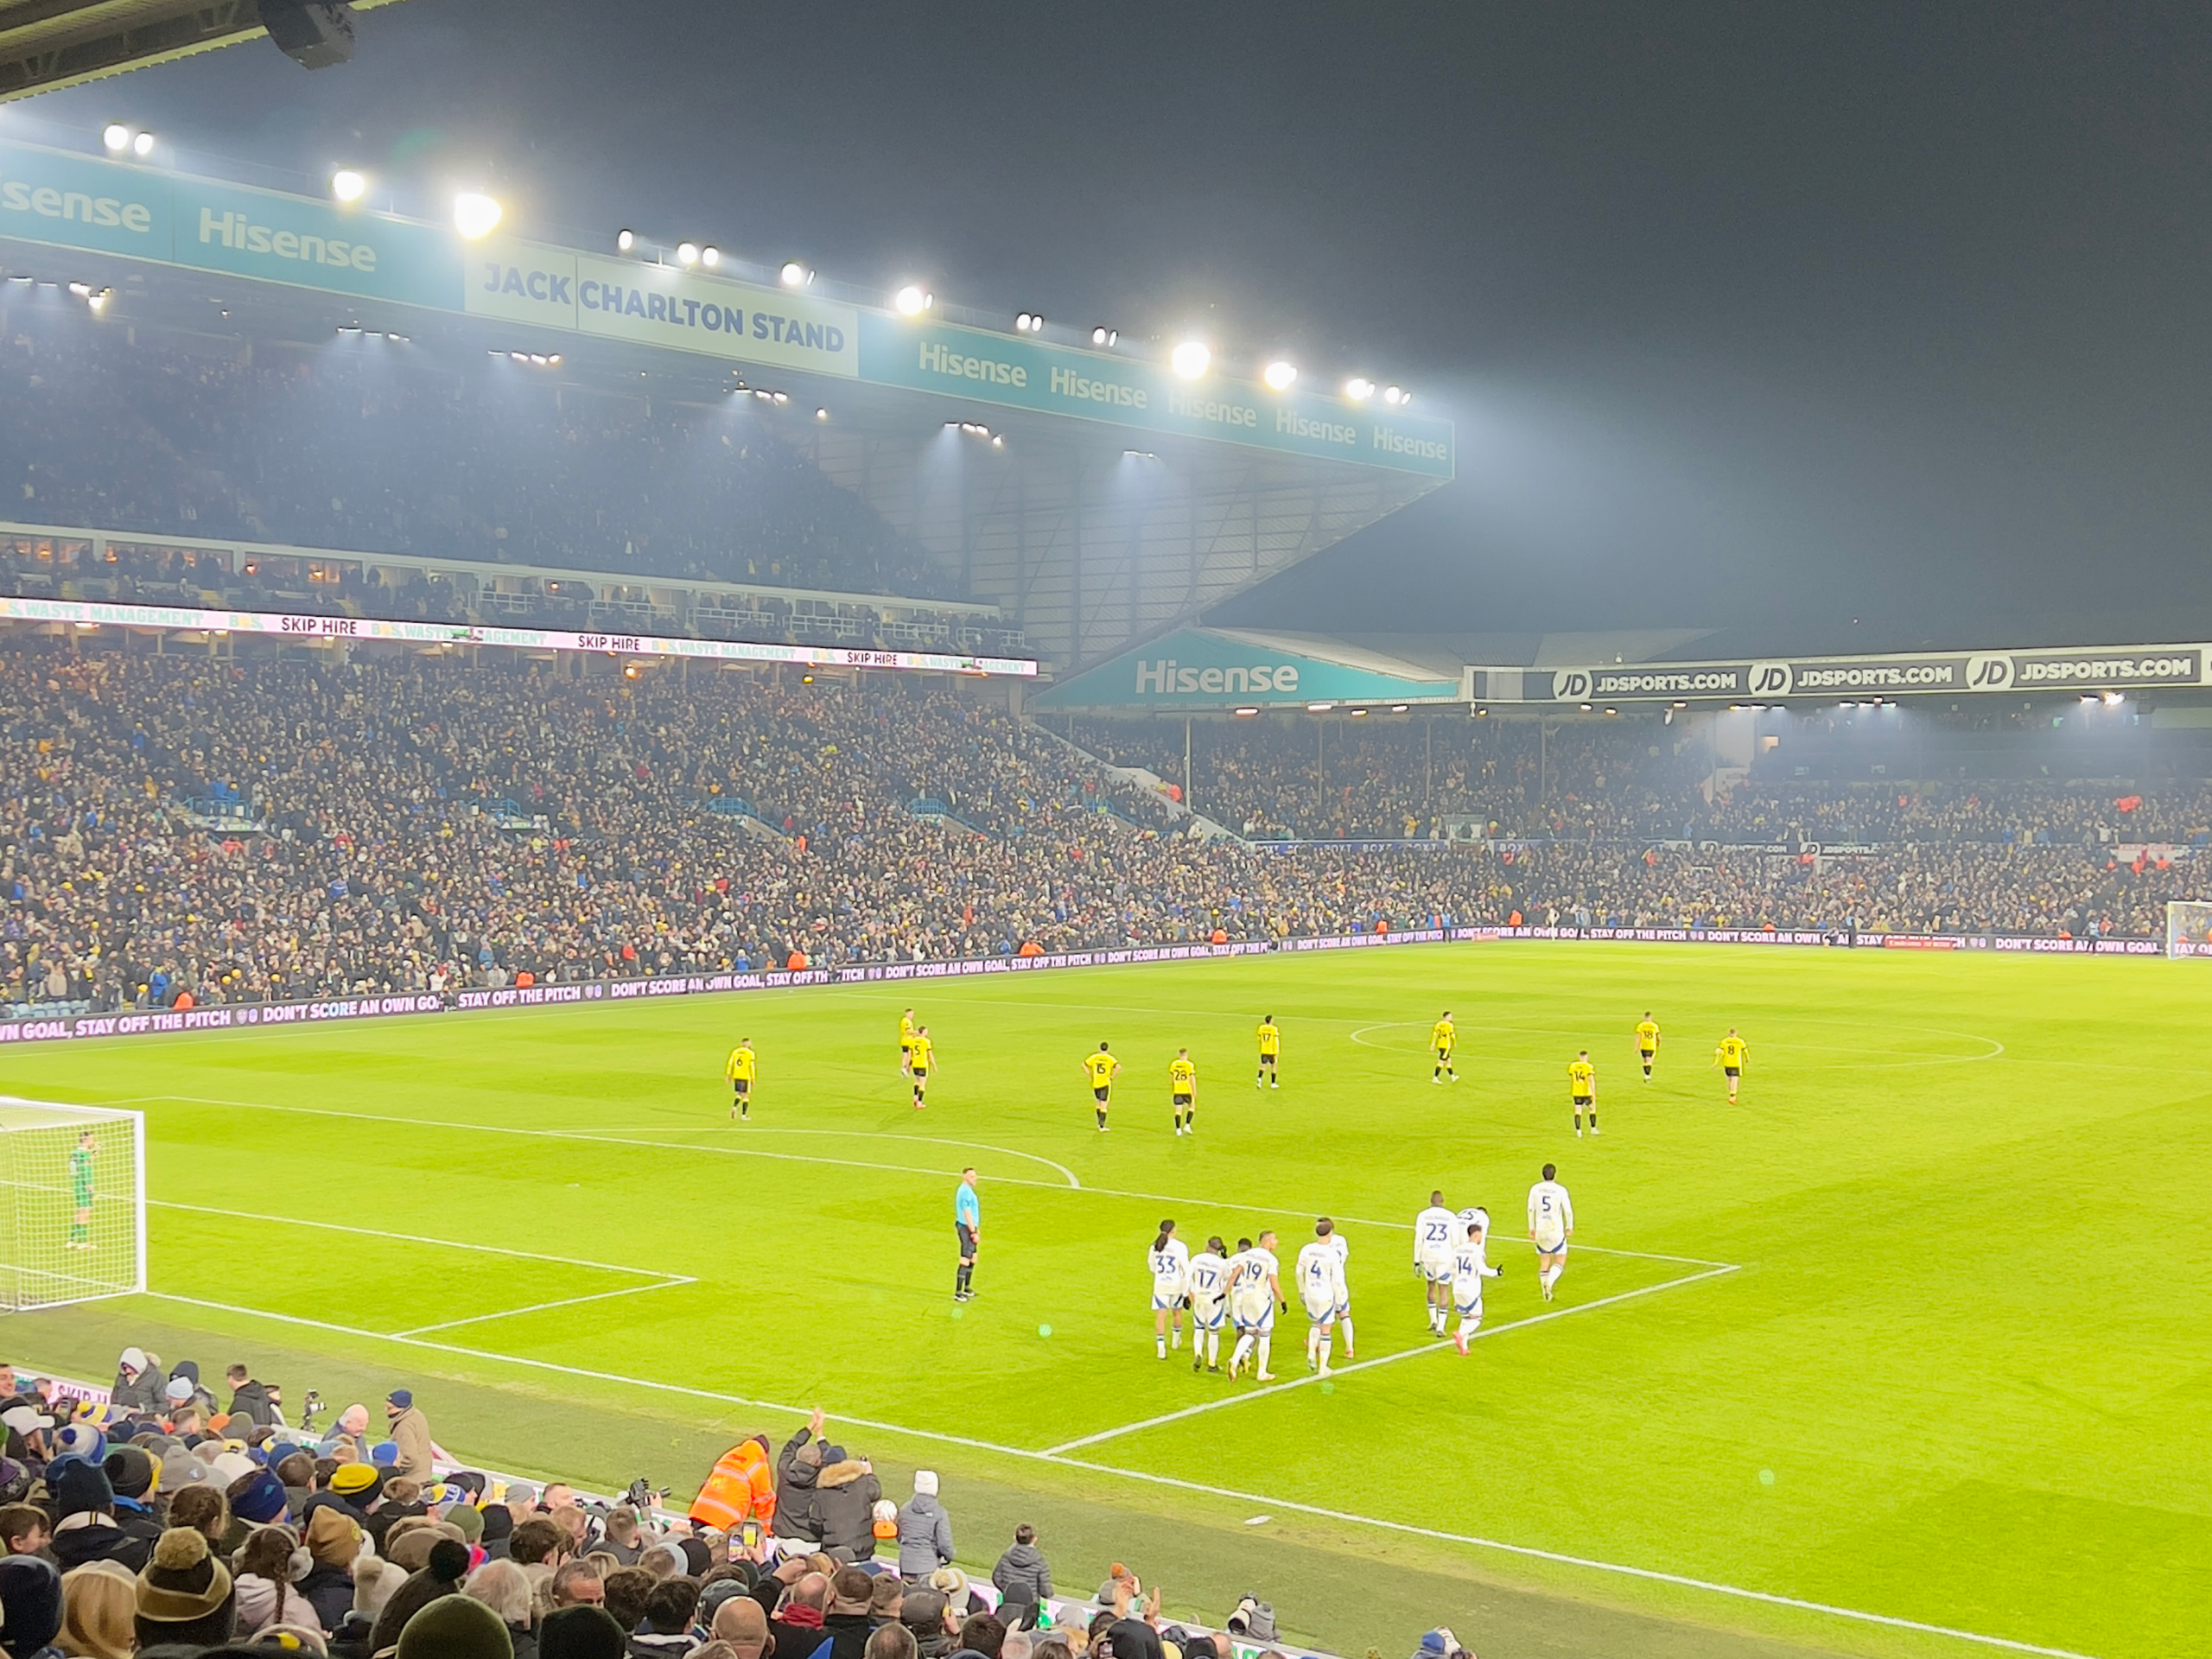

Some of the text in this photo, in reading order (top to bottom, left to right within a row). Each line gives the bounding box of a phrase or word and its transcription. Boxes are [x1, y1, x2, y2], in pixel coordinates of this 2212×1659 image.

[1, 180, 151, 233] sense
[200, 207, 377, 272] Hisense
[484, 262, 845, 353] JACK CHARLTON STAND
[918, 340, 1027, 388] Hisense
[1050, 366, 1148, 410] Hisense
[1168, 388, 1257, 428] Hisense
[1275, 407, 1357, 445] Hisense
[1373, 425, 1447, 461] Hisense
[26, 602, 83, 620] WASTE
[90, 605, 204, 626] MANAGEMENT
[282, 617, 358, 634] SKIP HIRE
[484, 630, 547, 645] AGEMENT
[578, 635, 641, 651] SKIP HIRE
[678, 642, 718, 655] WASTE
[721, 644, 797, 659] MANAGEMENT
[848, 652, 898, 665] SKIP HIRE
[982, 660, 1026, 672] AGEMENT
[1972, 658, 2192, 686] JD JDSPORTS.COM
[1135, 660, 1300, 694] Hisense
[1560, 672, 1737, 696] JD JDSPORTS.COM
[1754, 665, 1953, 691] JD JDSPORTS.COM
[1499, 842, 1525, 852] BOX
[1515, 928, 1531, 938] AN
[1591, 928, 1614, 938] STAY
[1615, 929, 1636, 939] OFF
[1636, 929, 1655, 940] THE
[1656, 930, 1687, 940] PITCH
[1707, 931, 1739, 942] DON'T
[1741, 931, 1776, 943] SCORE
[1777, 932, 1793, 943] AN
[1794, 933, 1821, 944] OWN
[1856, 934, 1885, 945] STAY
[1108, 950, 1133, 963] DON'T
[1133, 948, 1159, 962] SCORE
[1159, 947, 1172, 960] AN
[1172, 946, 1190, 958] OWN
[1212, 944, 1230, 956] STAY
[1230, 943, 1246, 955] OFF
[1246, 942, 1260, 953] THE
[1995, 938, 2032, 950] DON'T
[2033, 938, 2073, 950] SCORE
[2095, 940, 2126, 952] OWN
[886, 952, 1092, 979] DON'T SCORE AN OWN GOAL, STAY OFF THE PITCH
[611, 981, 648, 997] DON'T
[648, 978, 687, 995] SCORE
[688, 977, 705, 991] AN
[734, 973, 766, 988] GOAL,
[766, 971, 792, 987] STAY
[792, 969, 814, 985] OFF
[814, 969, 830, 983] TH
[838, 967, 865, 982] ITCH
[458, 991, 492, 1008] STAY
[492, 989, 518, 1006] OFF
[518, 988, 543, 1004] THE
[544, 985, 582, 1002] PITCH
[263, 1004, 308, 1022] DON'T
[309, 1001, 358, 1019] SCORE
[359, 998, 380, 1015] AN
[382, 996, 415, 1013] OWN
[22, 1020, 73, 1039] GOAL,
[74, 1017, 117, 1036] STAY
[118, 1014, 150, 1033] OFF
[151, 1013, 183, 1030] THE
[184, 1009, 232, 1028] PITCH
[913, 1045, 921, 1056] 5
[1541, 1195, 1552, 1212] 5
[1426, 1222, 1448, 1242] 23
[1154, 1255, 1176, 1274] 33
[1245, 1259, 1263, 1281] 19
[1310, 1259, 1322, 1278] 4
[1456, 1255, 1472, 1275] 14
[1198, 1268, 1217, 1289] 17
